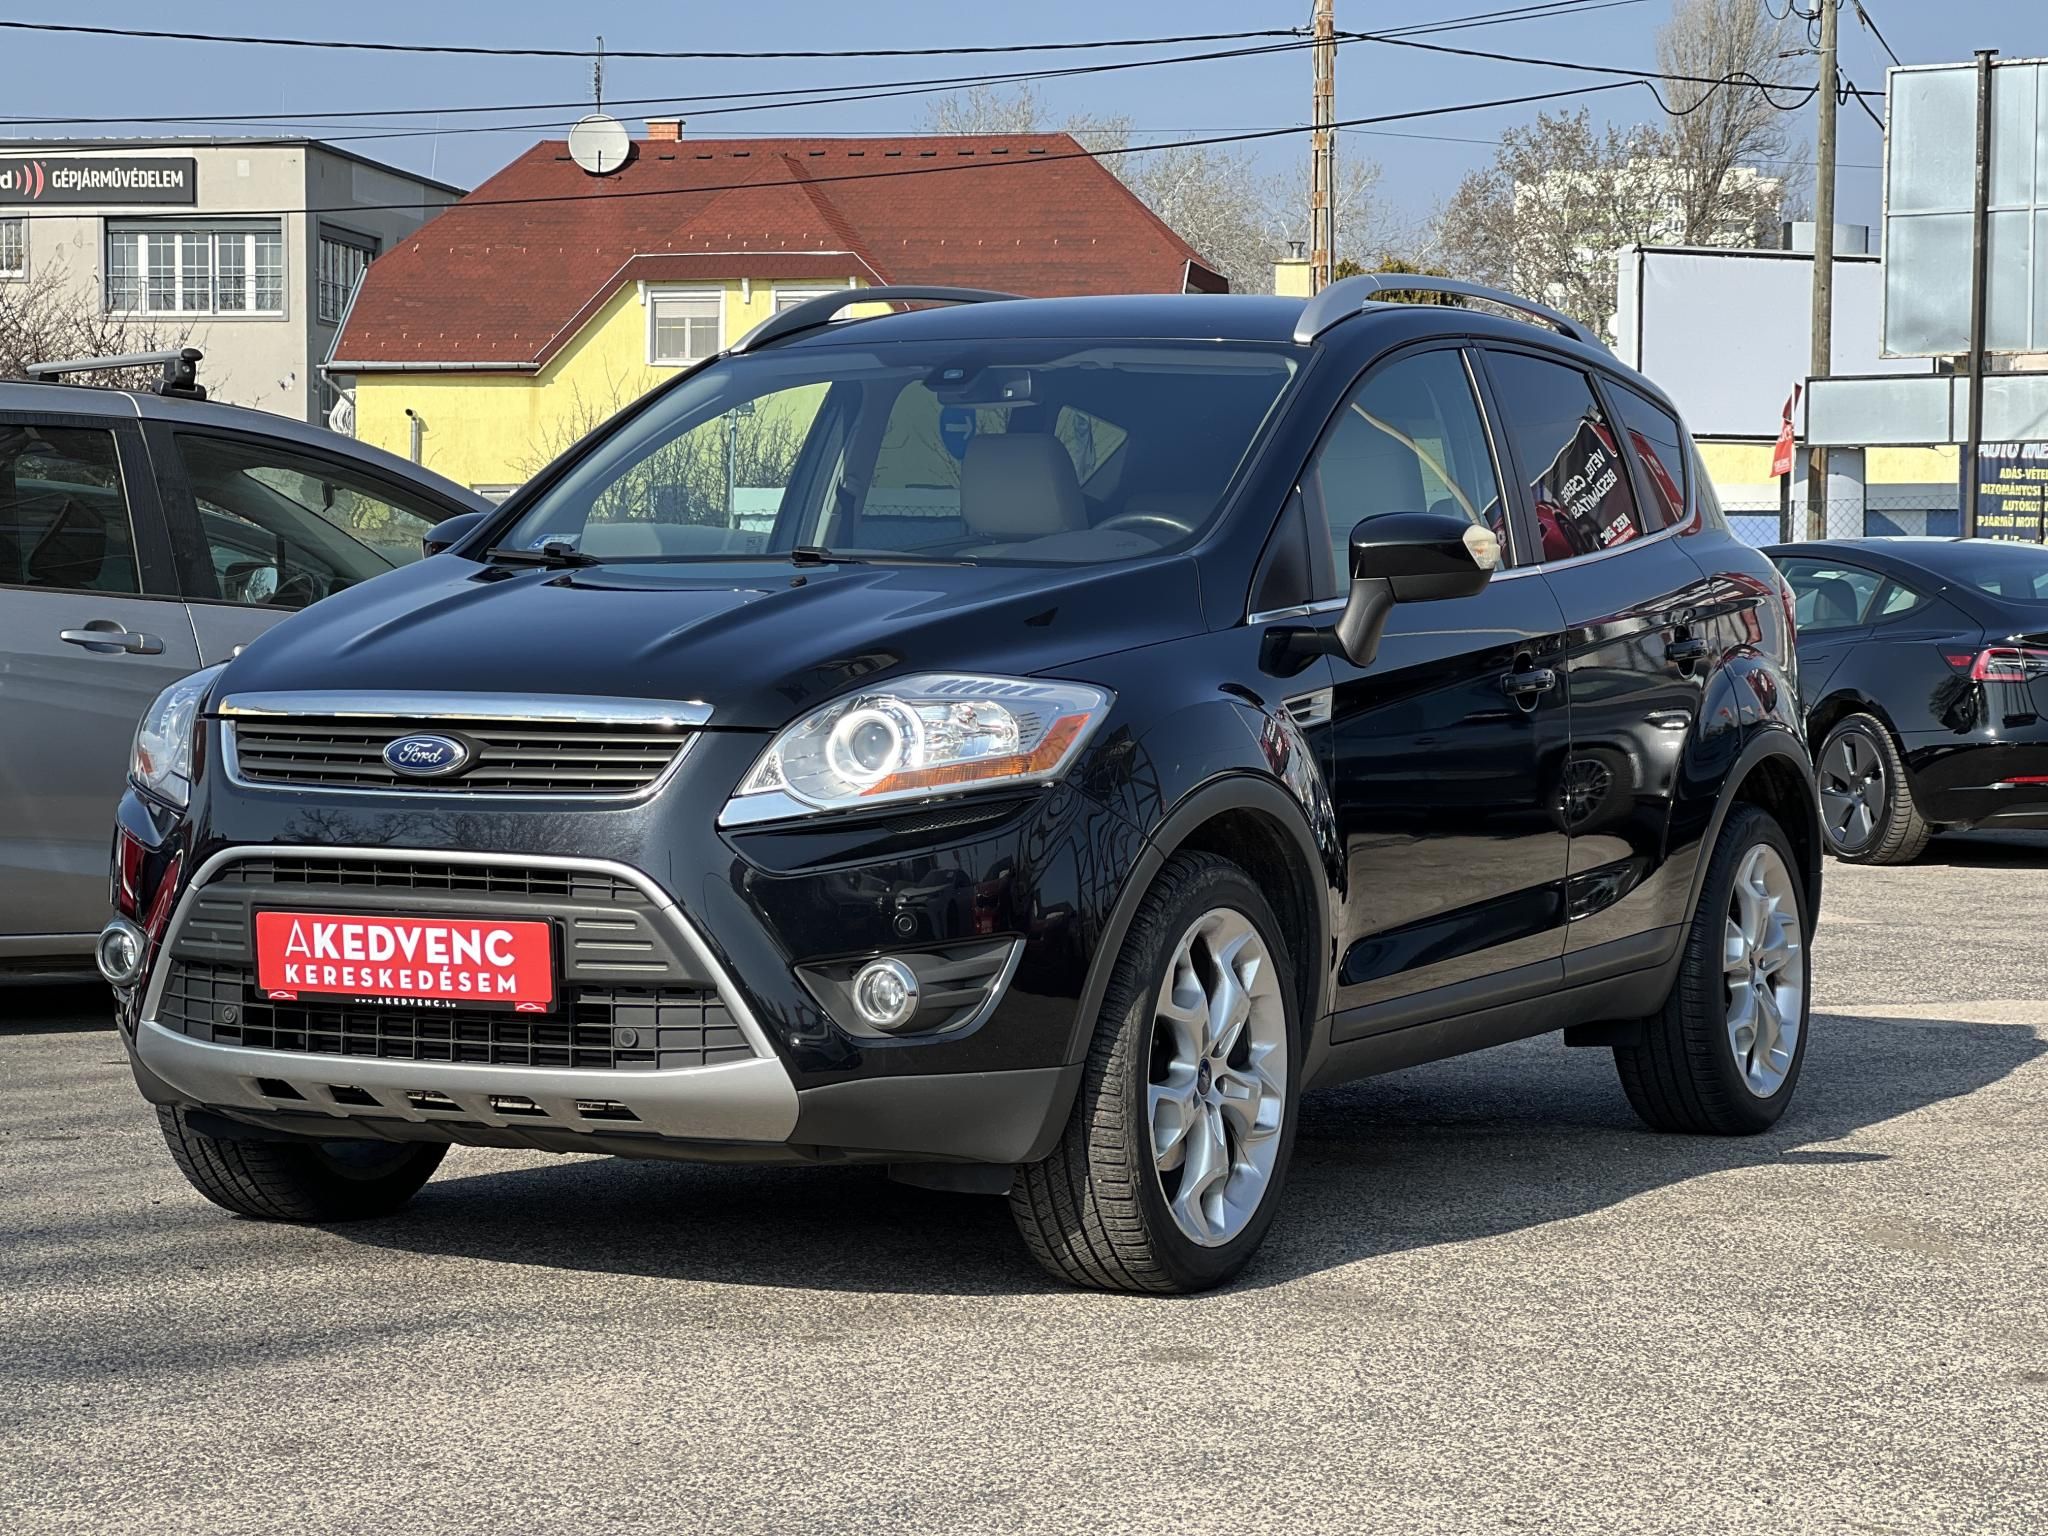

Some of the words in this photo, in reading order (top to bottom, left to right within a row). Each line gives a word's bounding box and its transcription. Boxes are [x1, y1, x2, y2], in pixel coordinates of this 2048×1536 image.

[52, 168, 184, 190] GÉPJÁRMŰVÉDELEM
[399, 742, 443, 763] Ford
[284, 964, 517, 994] KERESKEDÉSEM
